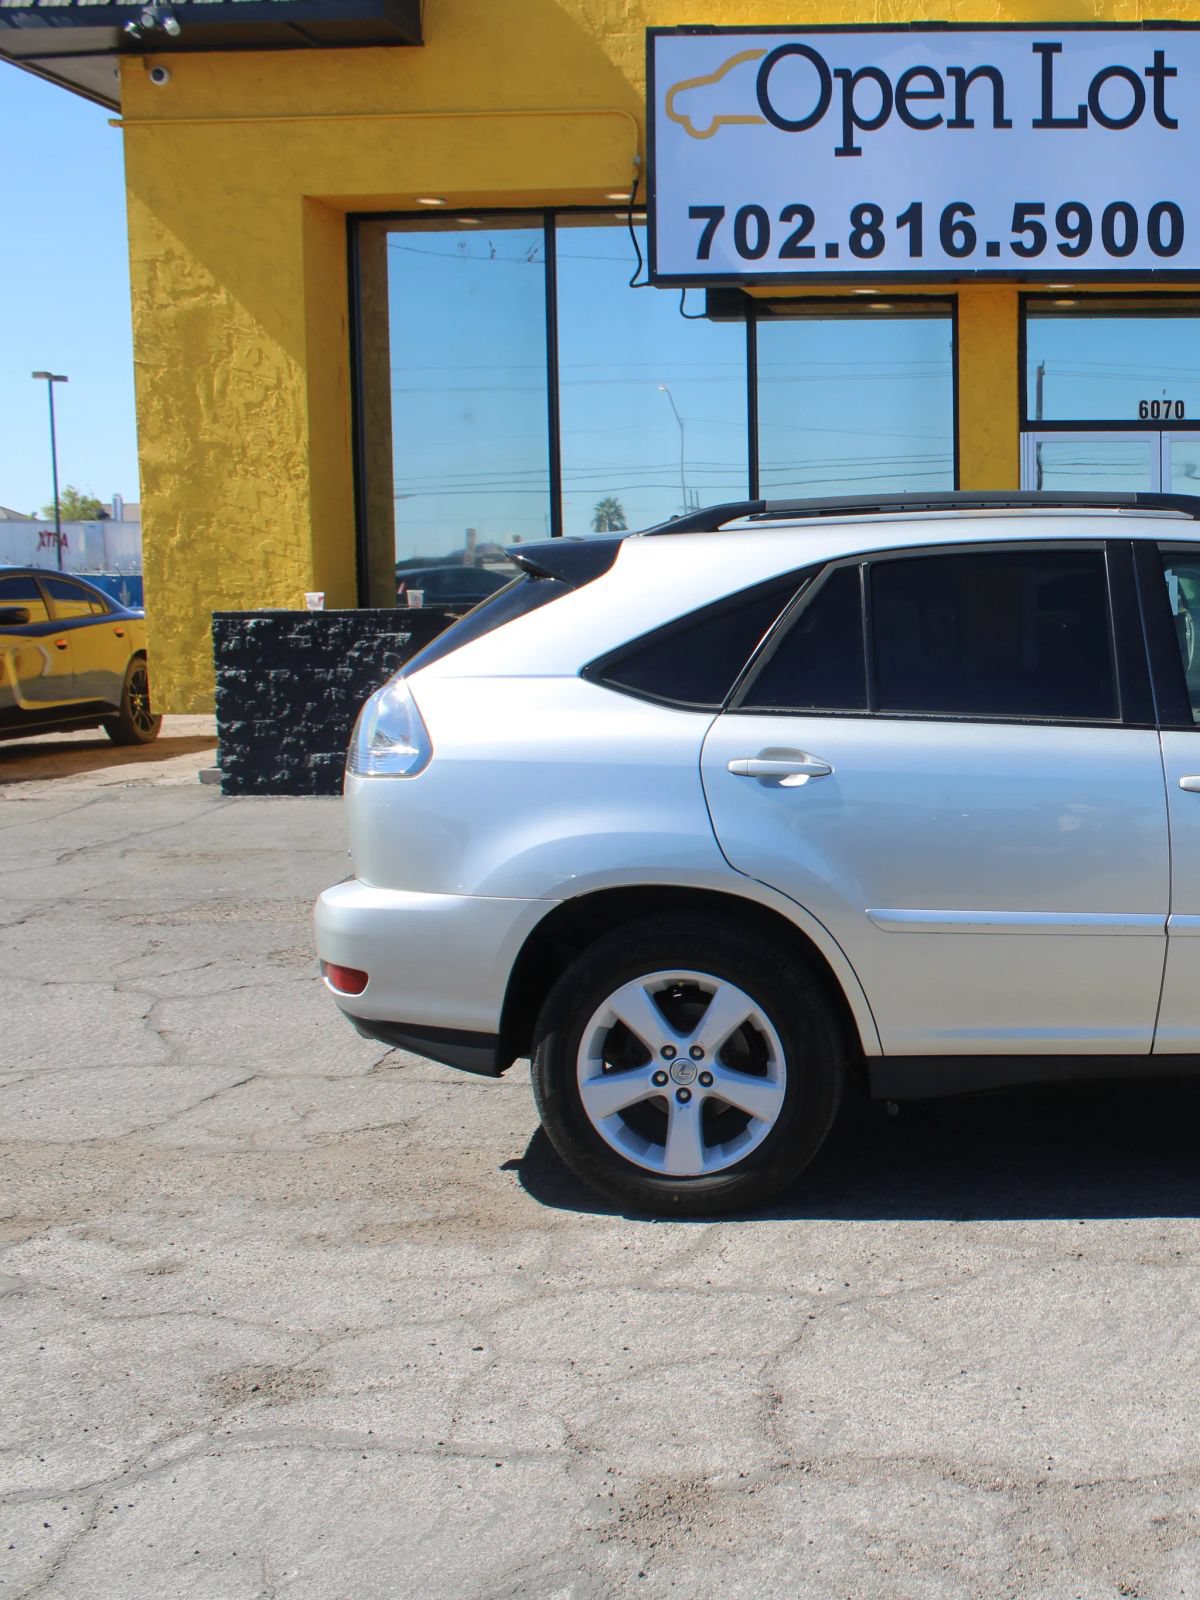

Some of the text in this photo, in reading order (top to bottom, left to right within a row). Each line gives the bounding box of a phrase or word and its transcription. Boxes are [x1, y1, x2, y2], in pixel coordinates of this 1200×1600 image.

[756, 42, 1012, 157] Open
[1031, 41, 1178, 130] Lot
[687, 201, 1185, 260] 702.816.5900
[1138, 399, 1185, 420] 6070
